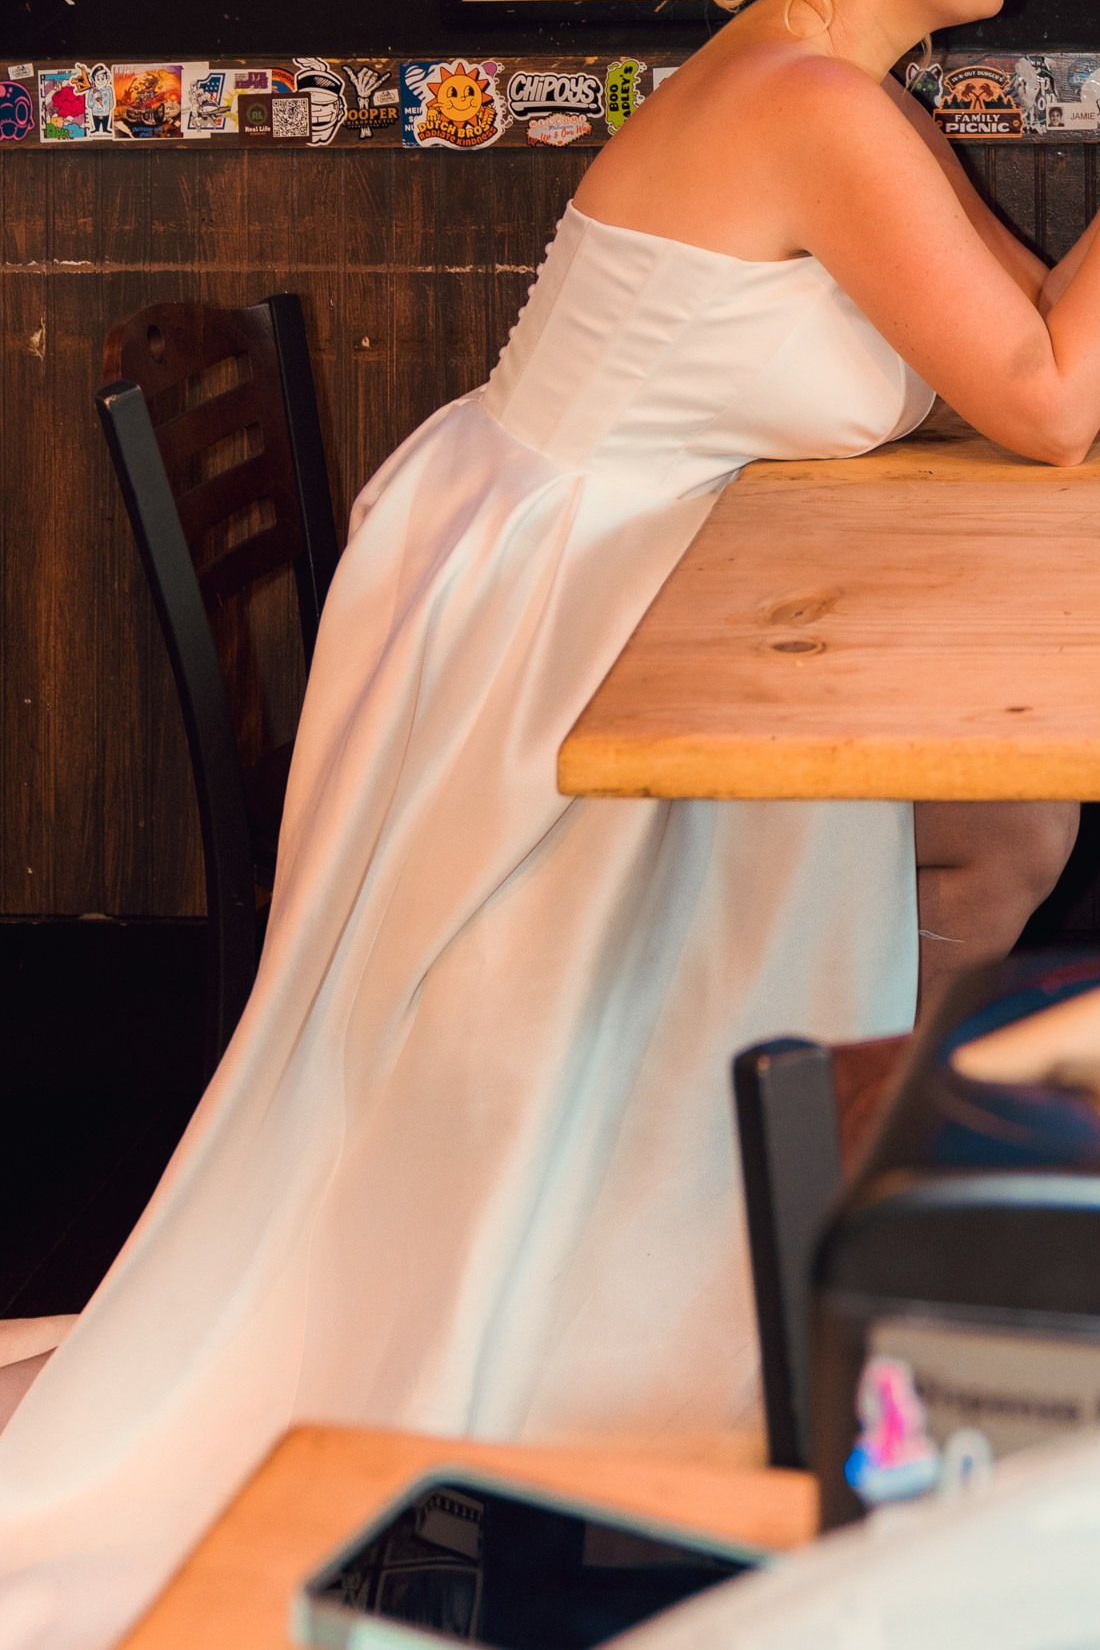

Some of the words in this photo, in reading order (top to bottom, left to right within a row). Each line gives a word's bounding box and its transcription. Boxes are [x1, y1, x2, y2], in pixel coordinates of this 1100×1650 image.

[610, 84, 619, 112] BOO
[620, 66, 633, 118] ADLEY'S
[347, 107, 398, 121] OOPER
[529, 114, 588, 128] WELCOME
[954, 114, 1001, 122] FAMILY
[1070, 112, 1096, 121] JAMIE
[417, 119, 457, 135] DUTCH
[457, 120, 490, 138] BROS
[945, 122, 1010, 133] PICNIC
